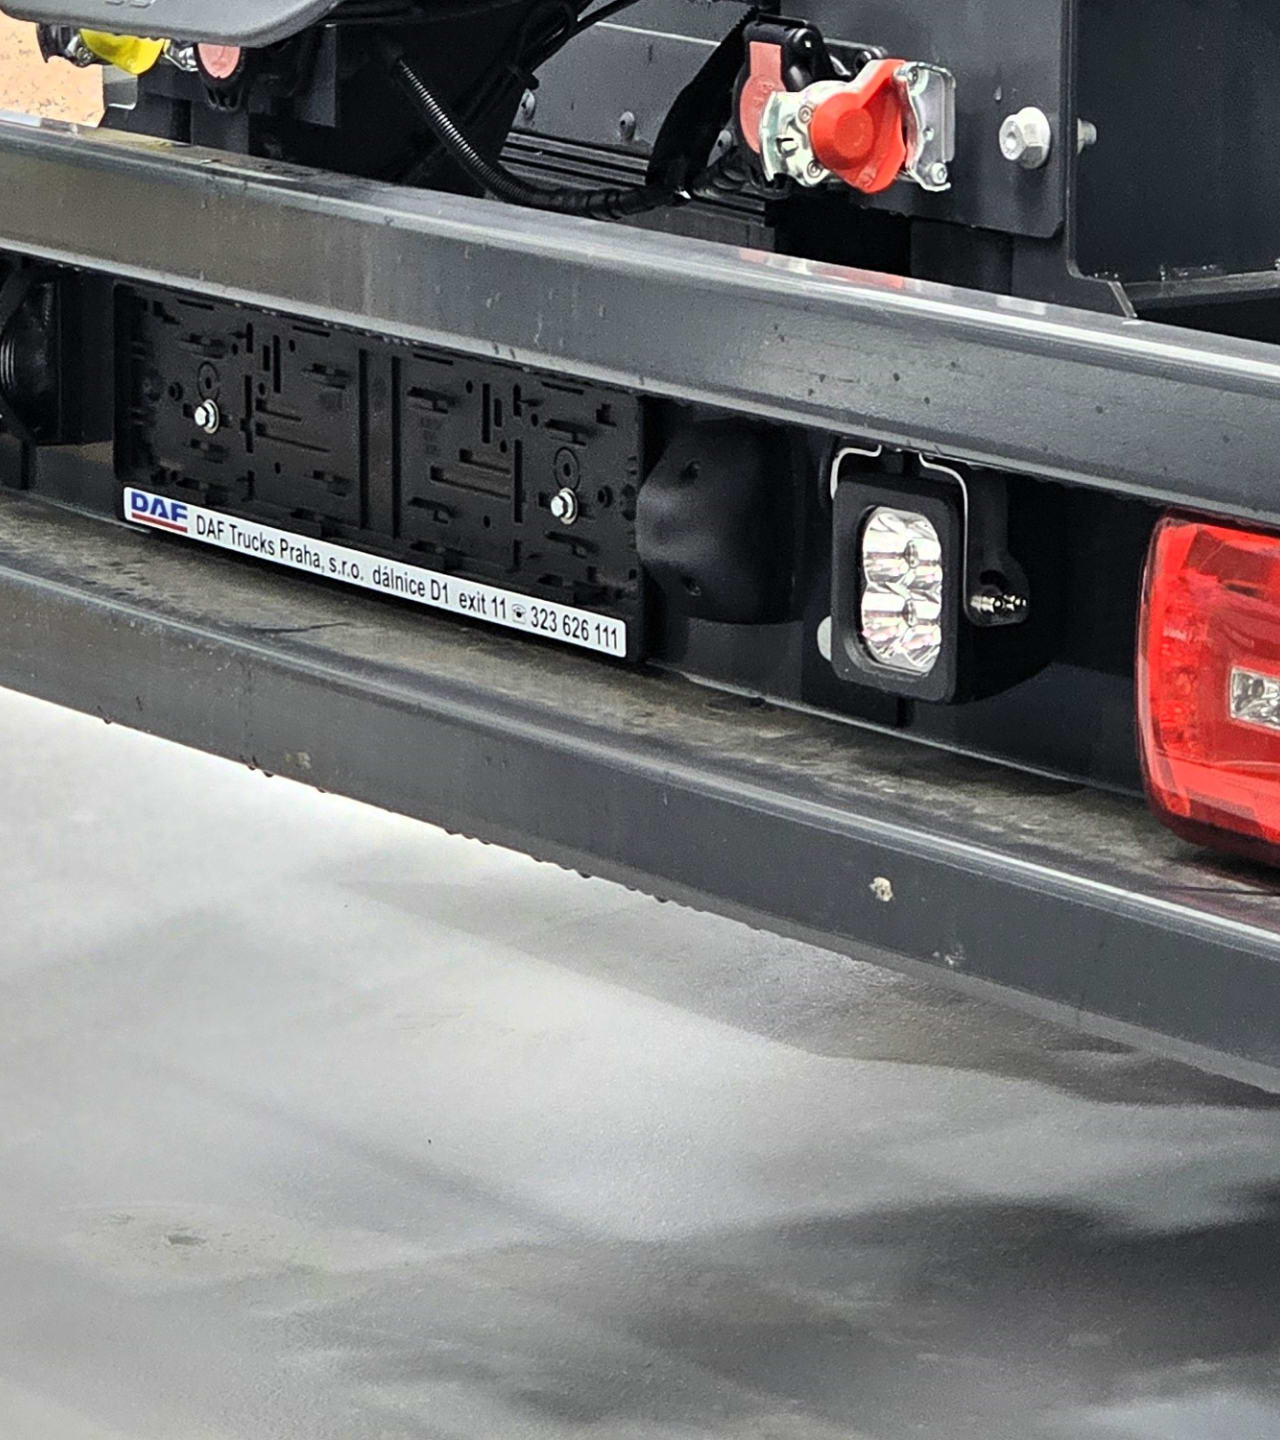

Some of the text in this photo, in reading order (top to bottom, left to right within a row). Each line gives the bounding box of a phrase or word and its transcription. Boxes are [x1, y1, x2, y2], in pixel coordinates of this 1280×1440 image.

[131, 491, 187, 522] DAF
[196, 514, 617, 649] DAF Trucks Praha, s.r.o. dálnice D1 exit 11 323 626 111
